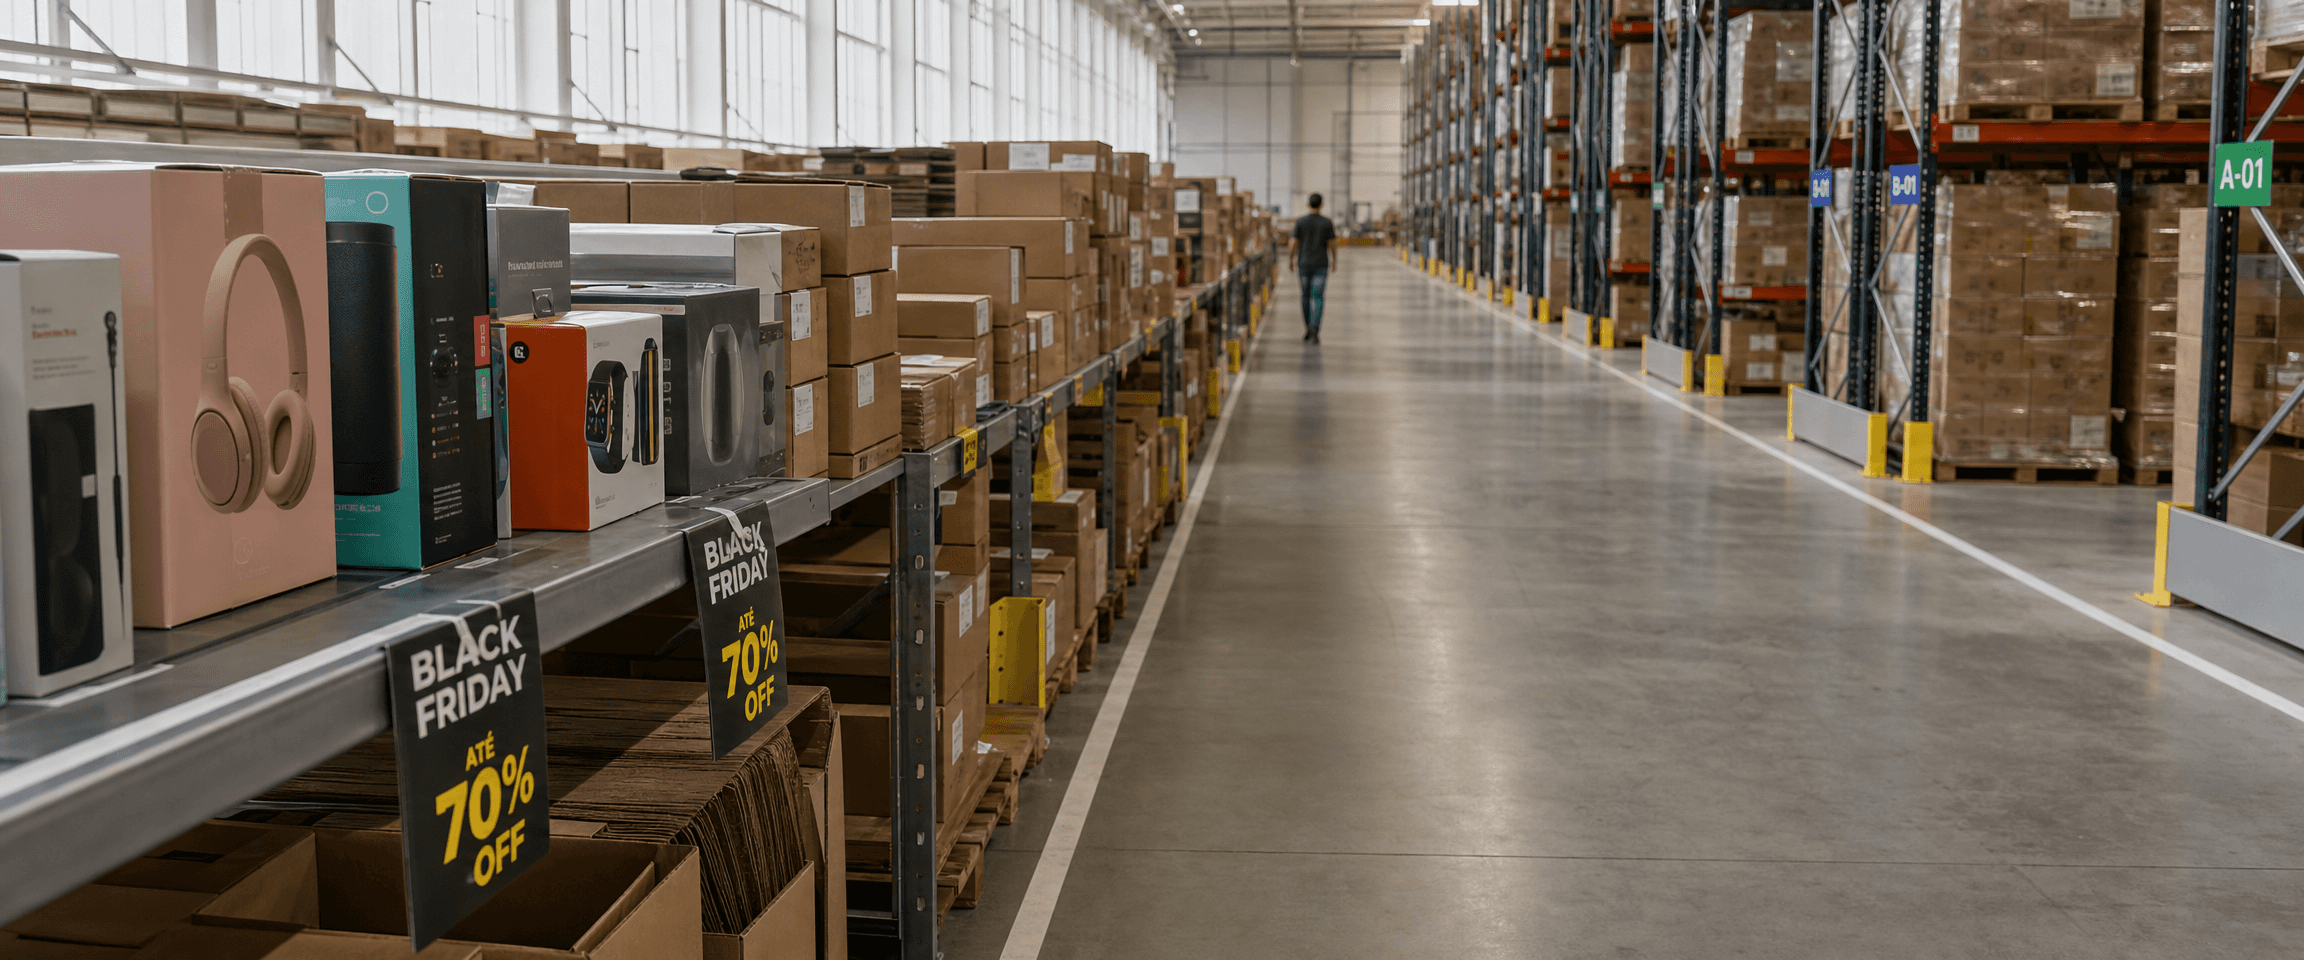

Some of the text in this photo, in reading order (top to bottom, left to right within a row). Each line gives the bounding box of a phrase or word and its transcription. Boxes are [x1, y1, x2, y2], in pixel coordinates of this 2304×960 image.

[1892, 175, 1917, 196] B-01
[2219, 157, 2264, 190] A-01
[703, 521, 766, 571] BLACK
[708, 549, 769, 605] FRIDAY
[738, 606, 755, 633] ATÉ
[410, 614, 523, 693] BLACK
[721, 619, 779, 700] 70%
[415, 653, 527, 739] FRIDAY
[744, 674, 775, 722] OFF
[465, 730, 496, 772] ATÉ
[435, 744, 535, 866] 70%
[473, 818, 526, 887] OFF
